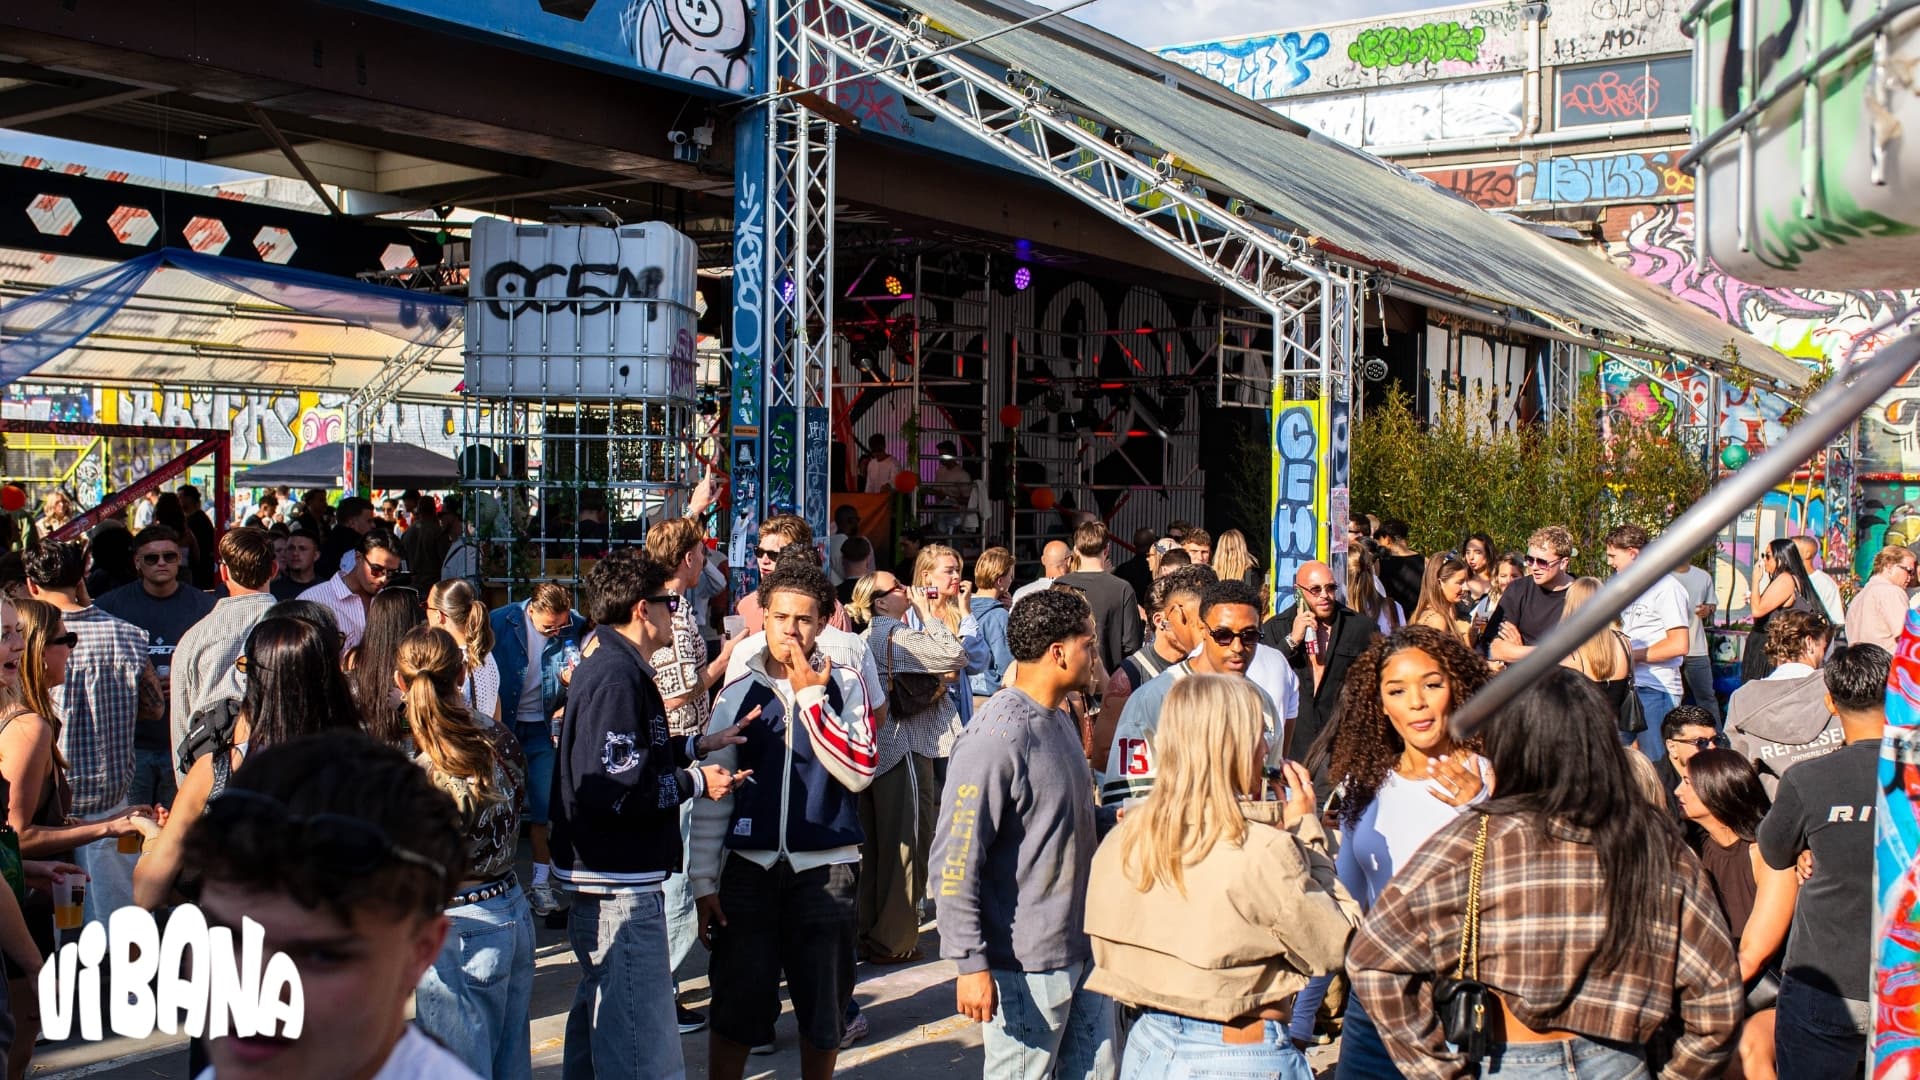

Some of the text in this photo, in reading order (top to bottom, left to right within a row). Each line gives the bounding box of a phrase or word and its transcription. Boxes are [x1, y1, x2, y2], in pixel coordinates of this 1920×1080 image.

[1118, 737, 1150, 776] 13
[1760, 728, 1845, 760] REPSE
[1828, 805, 1878, 822] RI
